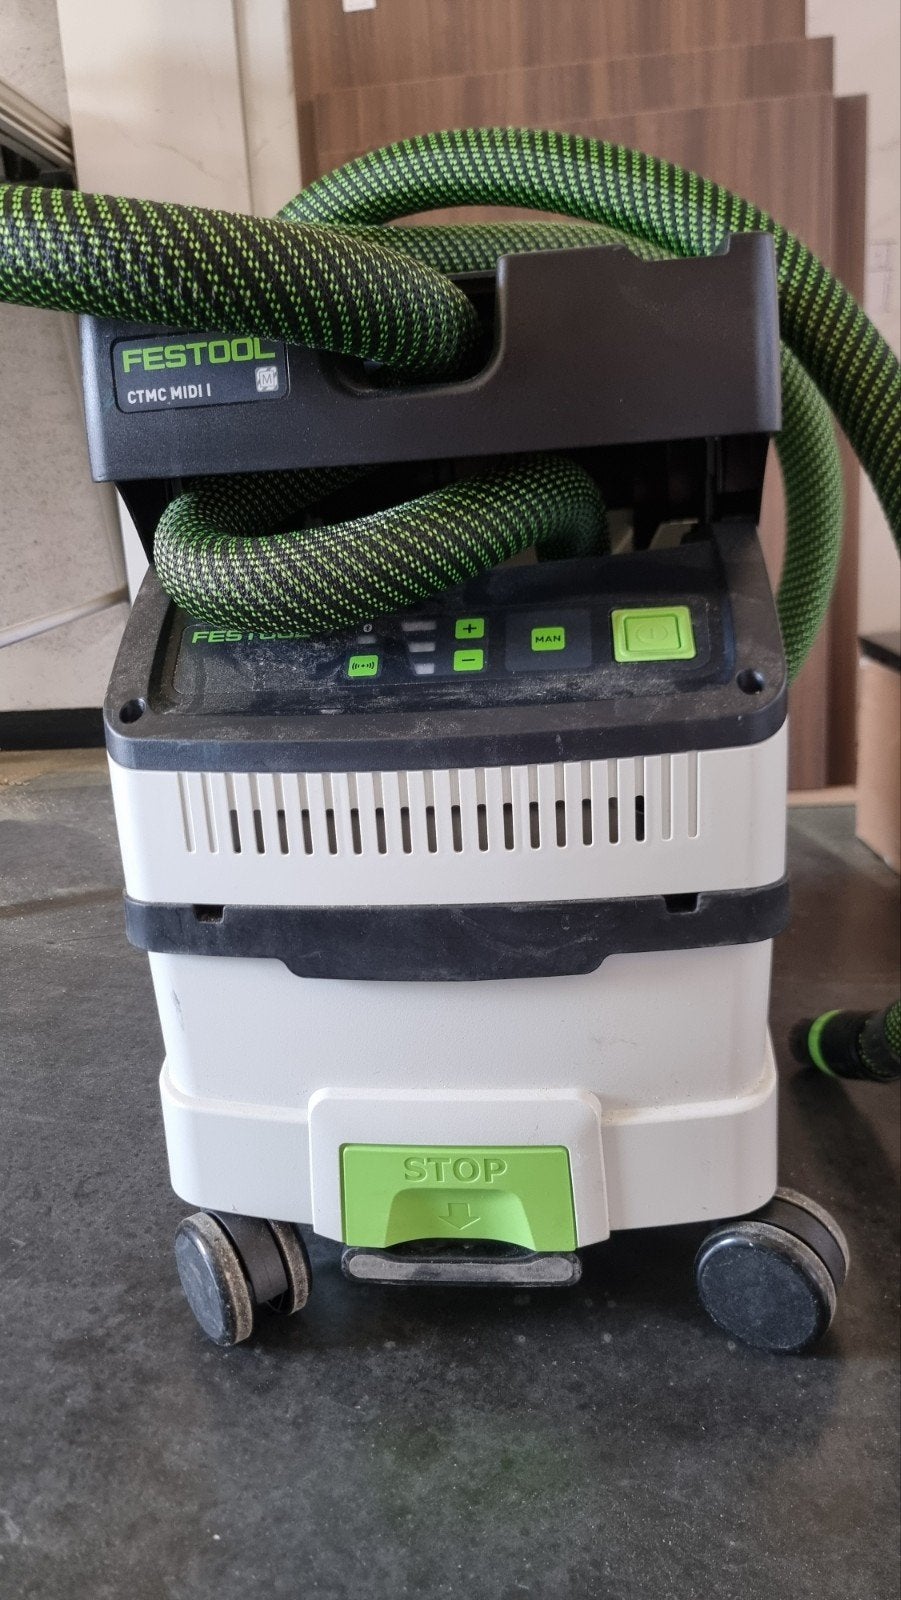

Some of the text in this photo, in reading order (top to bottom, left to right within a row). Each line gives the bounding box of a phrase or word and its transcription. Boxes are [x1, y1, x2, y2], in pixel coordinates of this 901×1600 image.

[122, 337, 276, 373] FESTOOL
[127, 388, 167, 404] CTMC
[170, 384, 203, 400] MIDI
[535, 635, 561, 643] MAN
[403, 1156, 508, 1183] STOP
